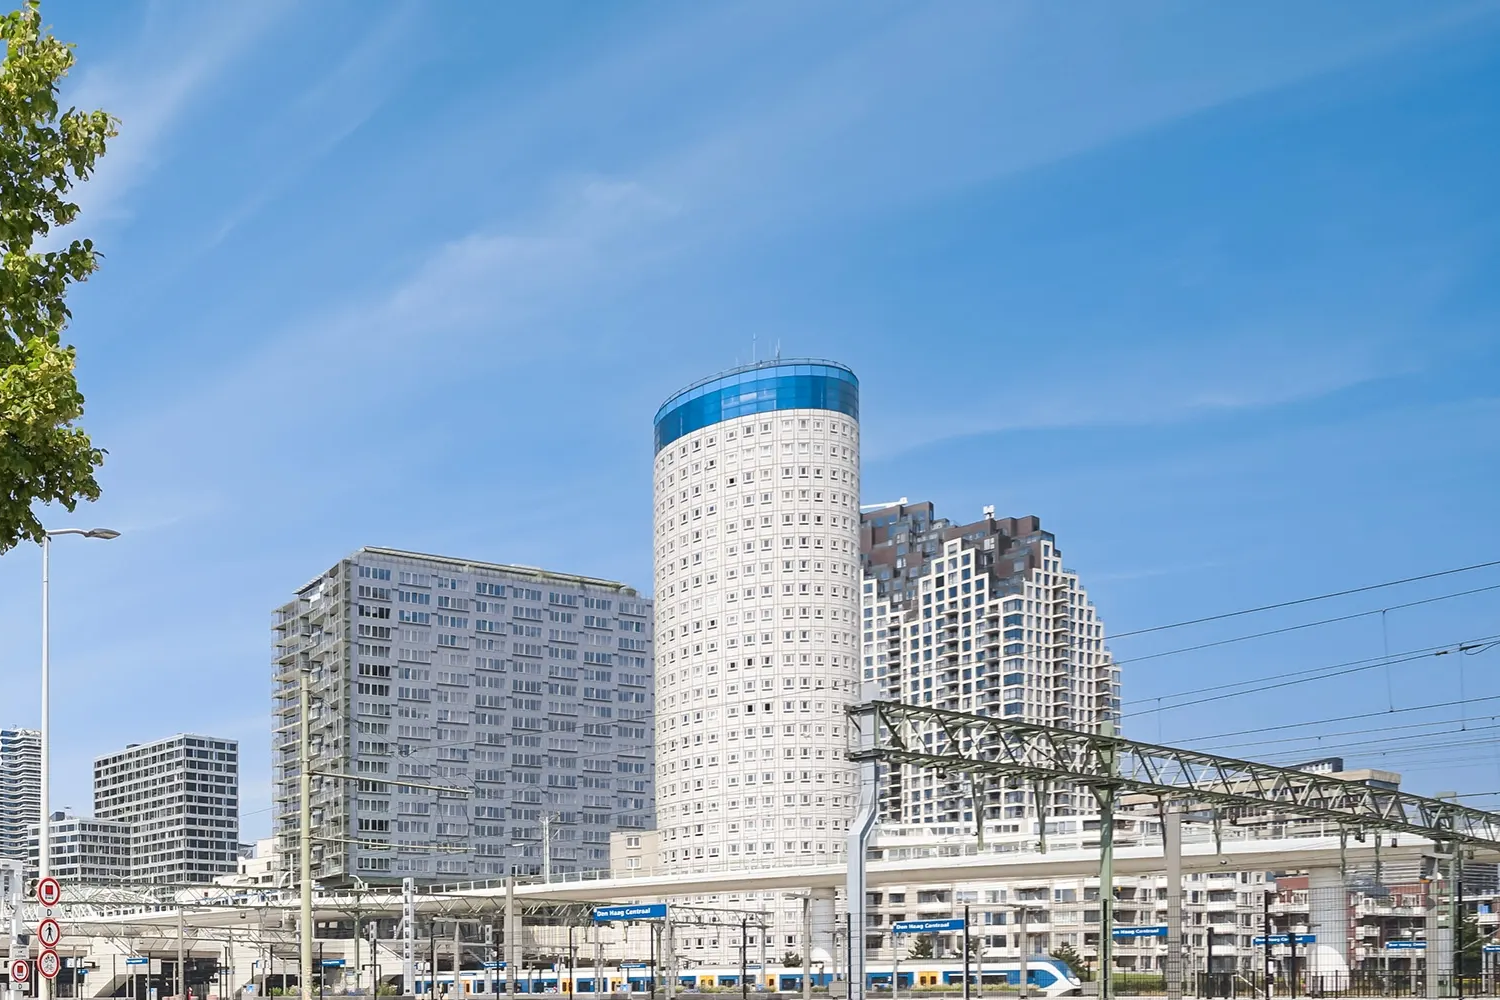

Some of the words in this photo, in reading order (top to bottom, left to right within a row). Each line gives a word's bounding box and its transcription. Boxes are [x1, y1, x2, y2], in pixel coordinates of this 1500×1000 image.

[47, 909, 52, 917] D
[609, 909, 625, 917] Haag
[625, 907, 651, 915] Centraal
